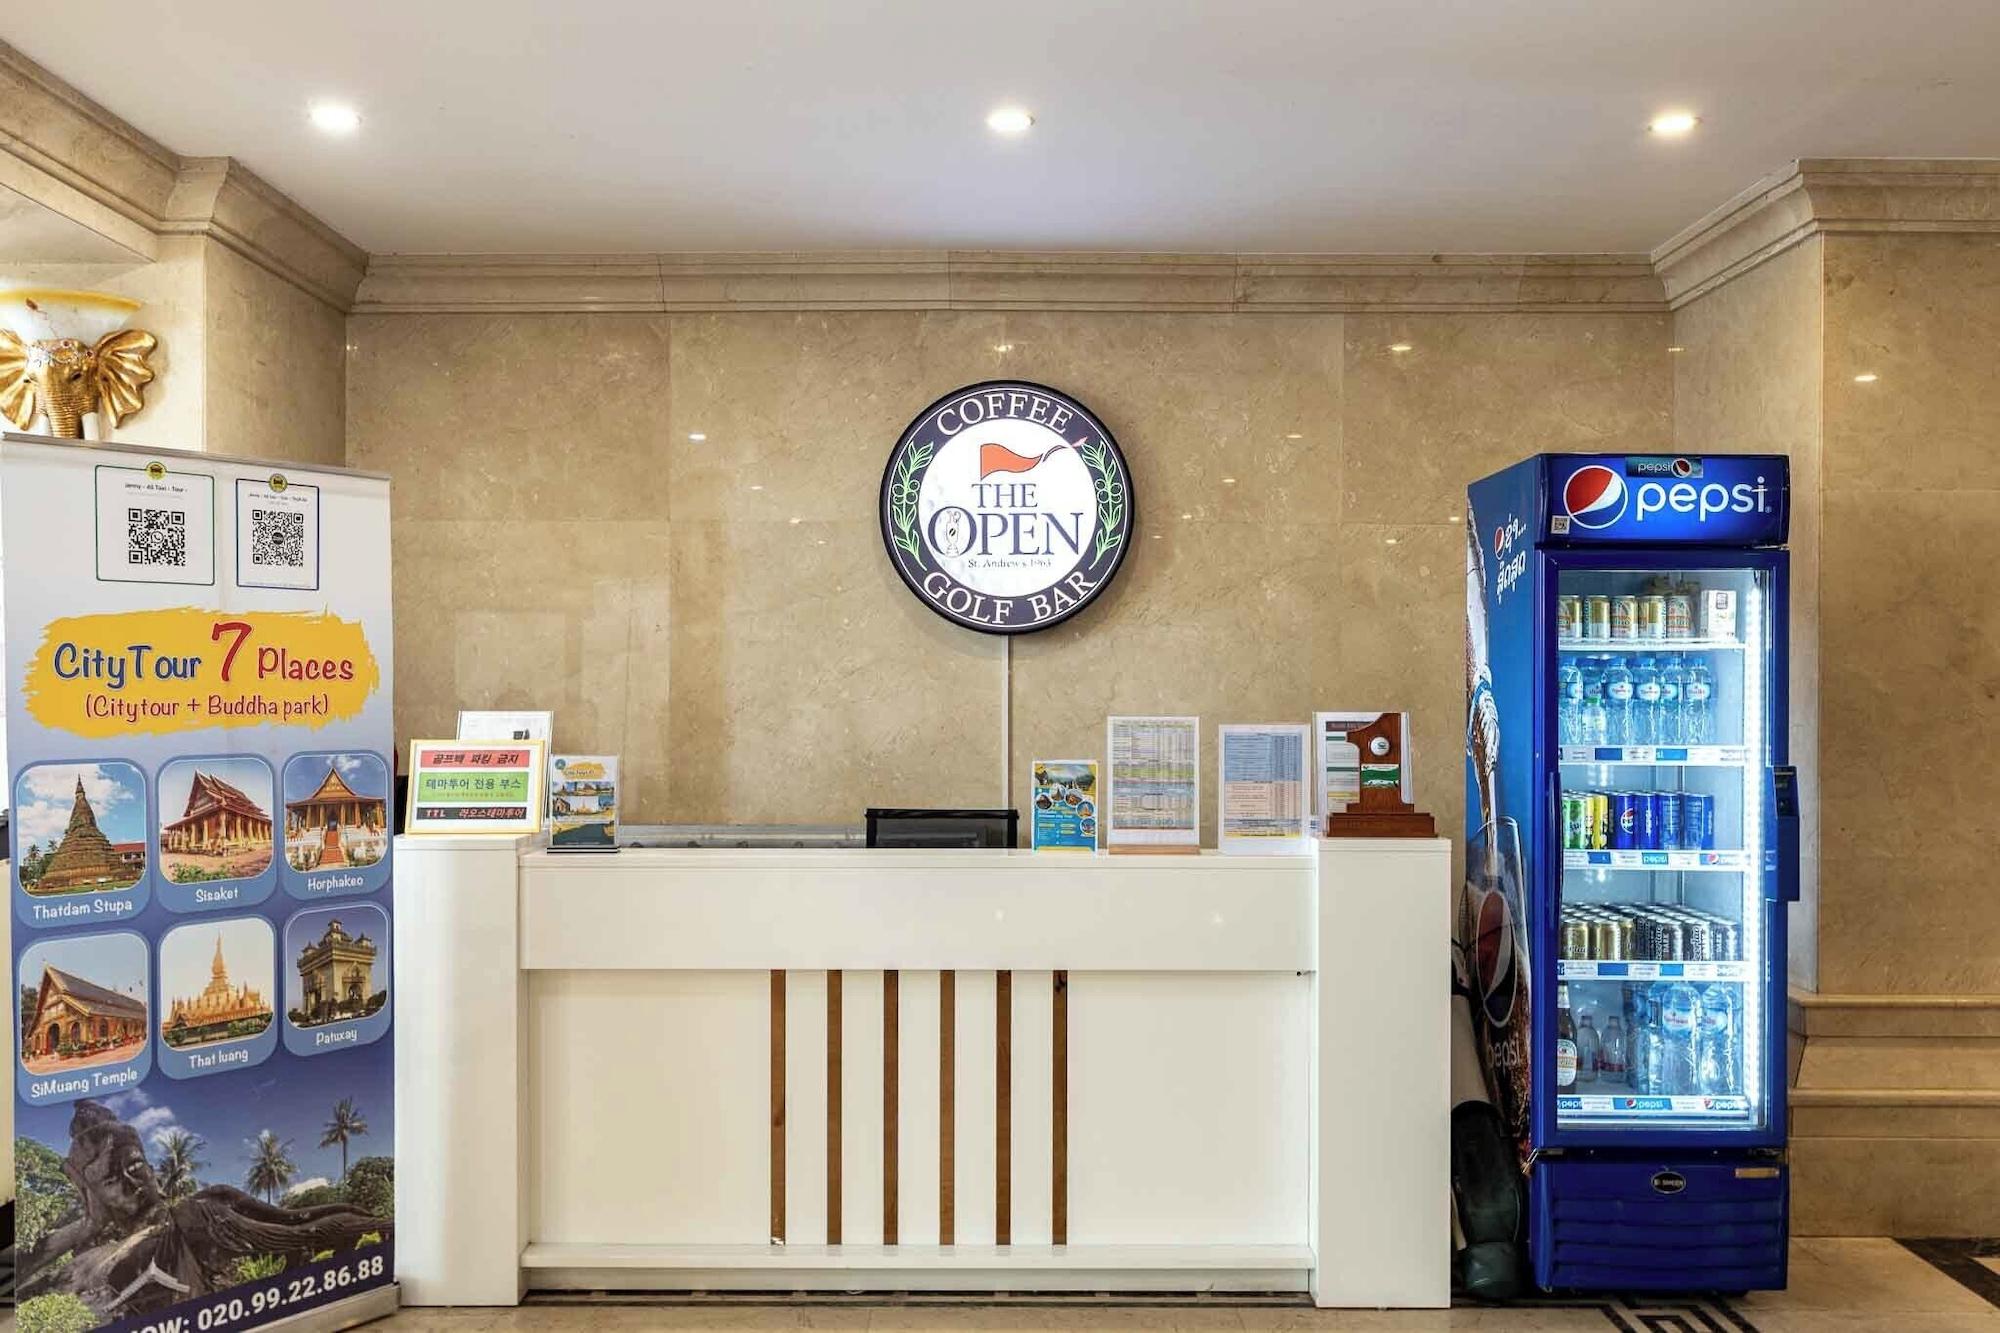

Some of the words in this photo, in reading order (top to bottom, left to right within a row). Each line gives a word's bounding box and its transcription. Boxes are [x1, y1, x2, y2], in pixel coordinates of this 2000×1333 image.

[936, 392, 1074, 436] COFFEE
[1637, 461, 1671, 474] pepsi
[971, 483, 1039, 509] THE
[1636, 476, 1765, 522] pepsi
[927, 505, 1084, 557] OPEN
[923, 571, 1014, 625] GOLF
[1027, 570, 1099, 622] BAR
[211, 621, 253, 682] 7
[257, 647, 355, 681] Places
[187, 699, 200, 712] +
[208, 694, 278, 716] Buddha
[283, 693, 329, 725] park)
[425, 778, 469, 790] 테마투어
[474, 778, 495, 790] 전용
[500, 778, 522, 790] 부스
[195, 887, 239, 903] Sisaket
[307, 876, 364, 894] Horphakeo
[33, 901, 91, 920] Thatdam
[93, 898, 133, 917] Stupa
[316, 1028, 358, 1046] Patuxay
[189, 1053, 217, 1069] That
[217, 1048, 249, 1066] luang
[31, 1075, 90, 1098] SiMuang
[93, 1067, 138, 1088] Temple
[1637, 1099, 1664, 1110] pepsi
[130, 1316, 191, 1333] OW:
[197, 1255, 384, 1332] 020.99.22.86.88
